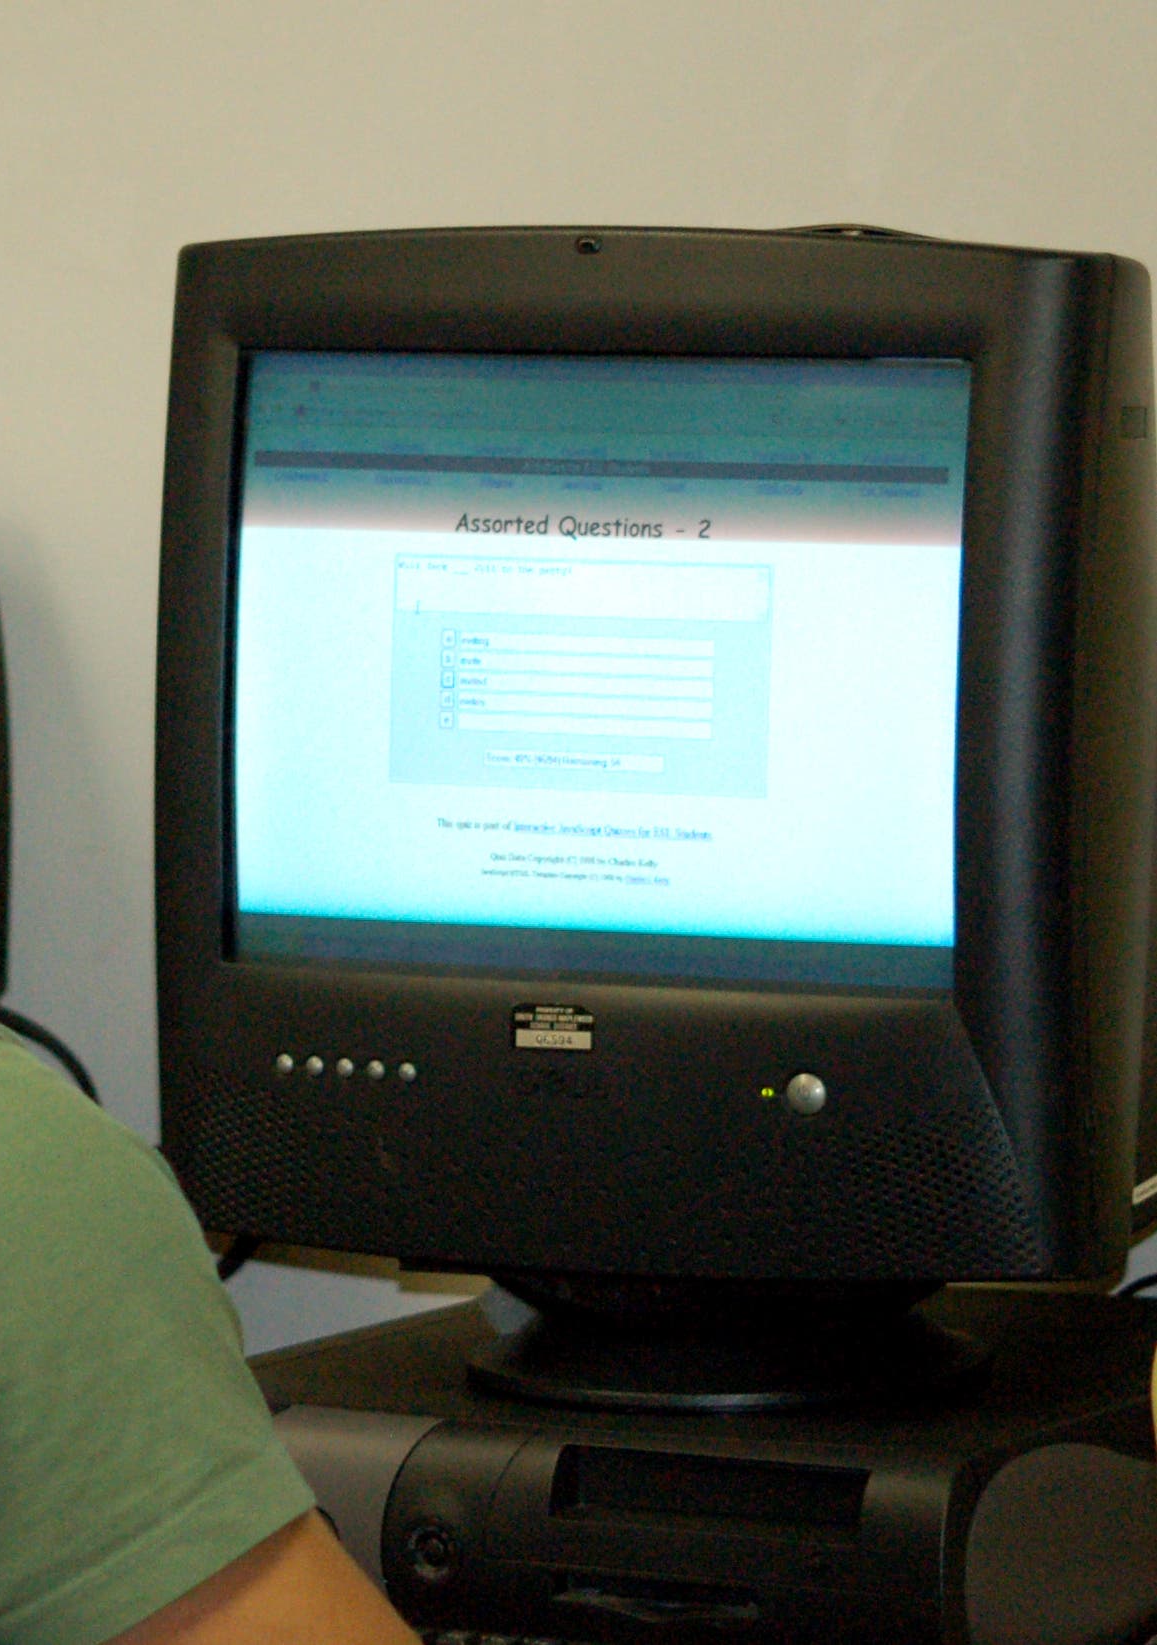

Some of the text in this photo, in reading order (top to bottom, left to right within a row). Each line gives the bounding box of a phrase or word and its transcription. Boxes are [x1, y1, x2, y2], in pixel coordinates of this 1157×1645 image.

[455, 512, 550, 536] Assorted
[557, 514, 664, 541] Questions
[697, 518, 712, 539] 2
[437, 817, 453, 829] This
[455, 821, 472, 832] quiz
[482, 821, 500, 833] part
[501, 819, 513, 830] of
